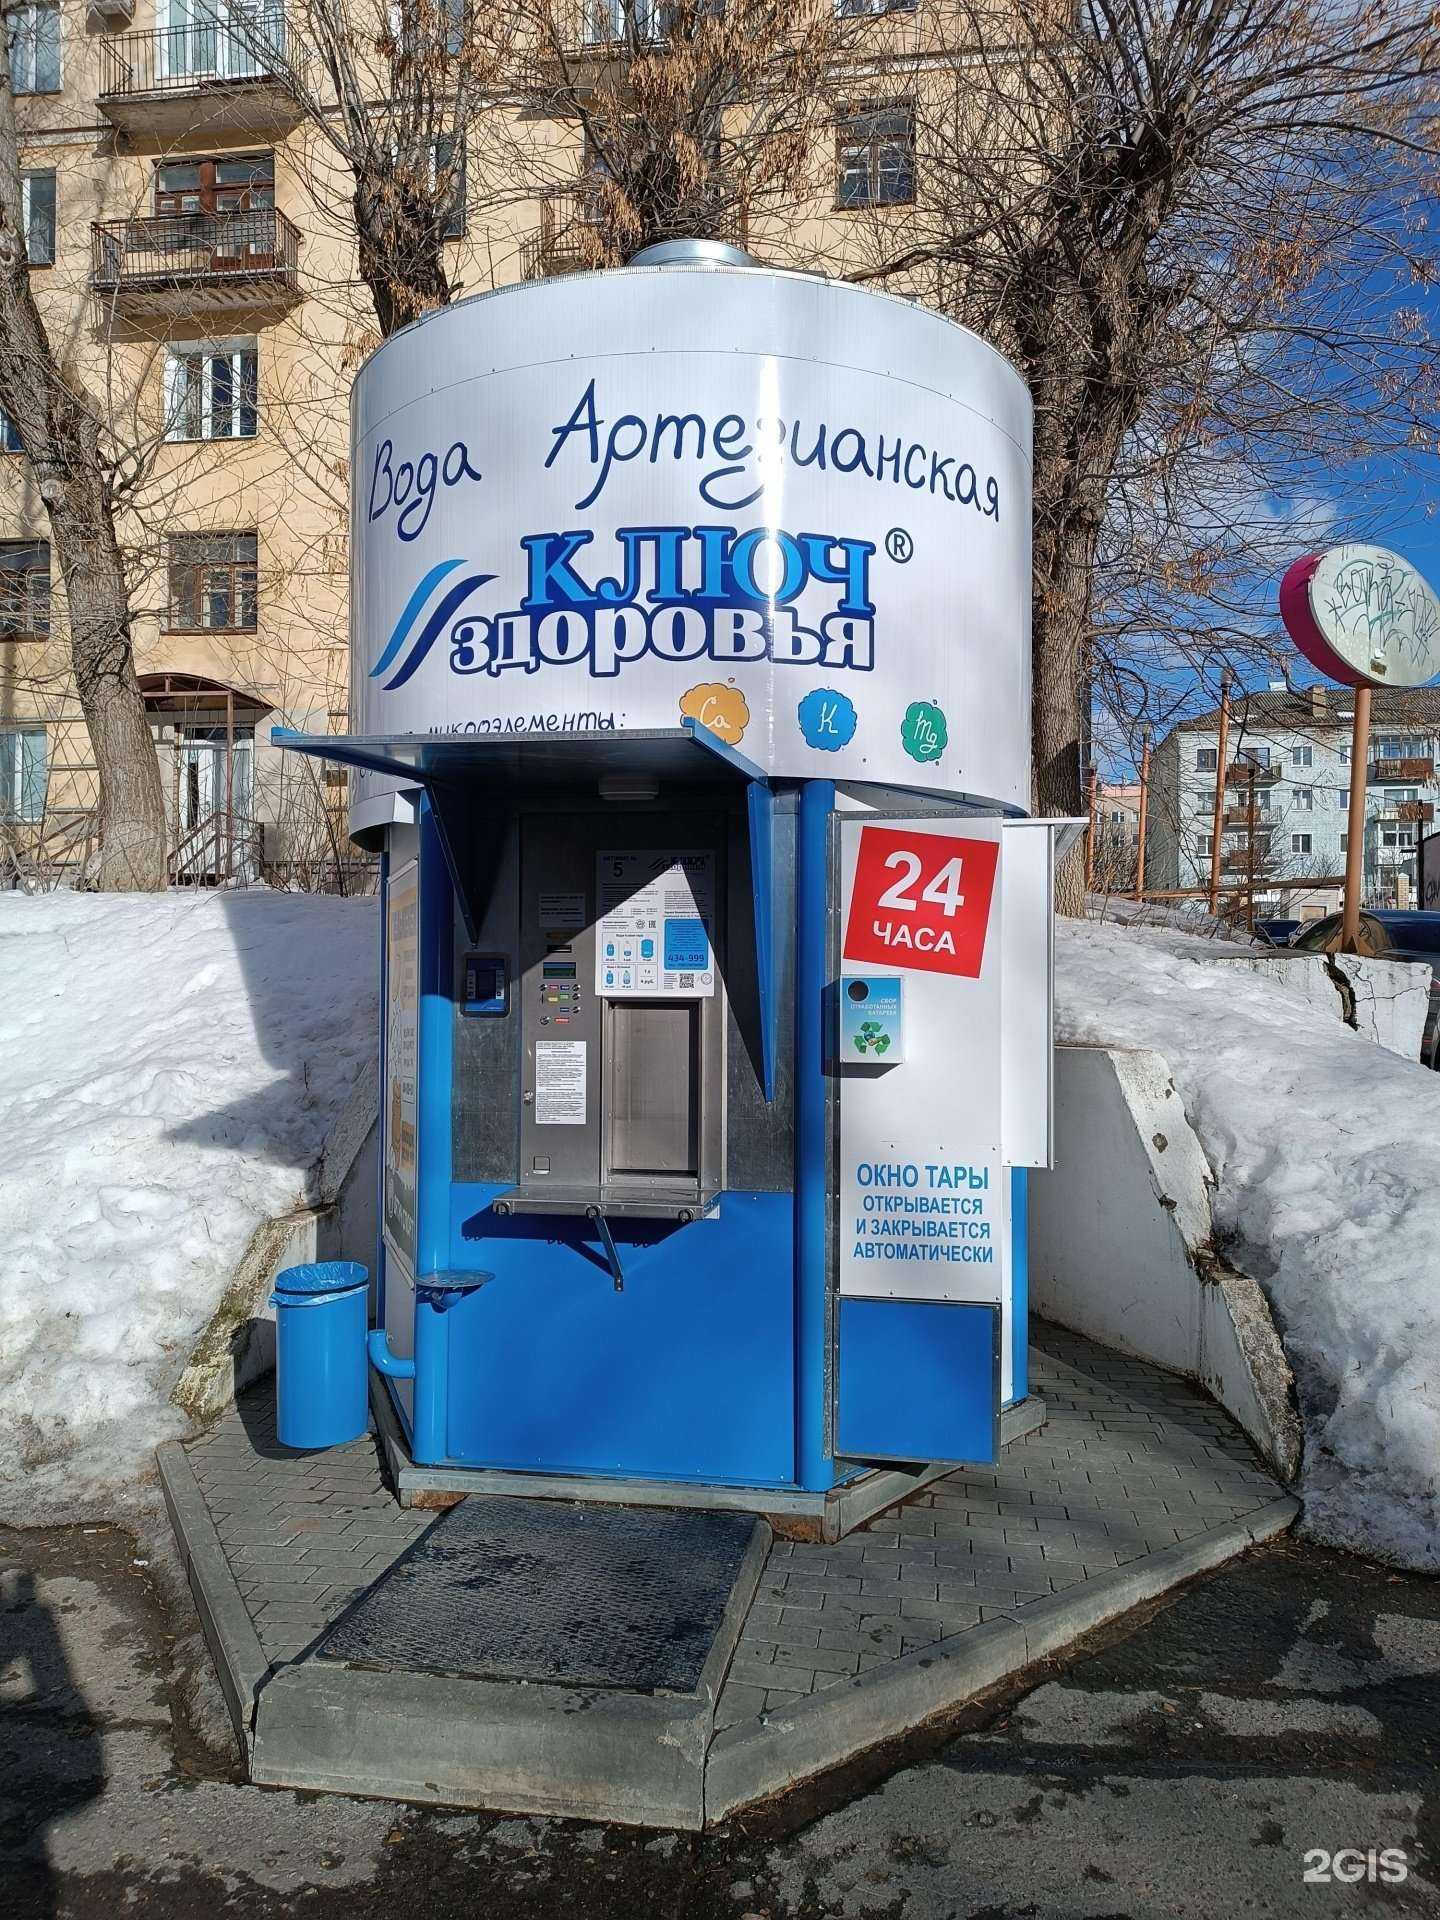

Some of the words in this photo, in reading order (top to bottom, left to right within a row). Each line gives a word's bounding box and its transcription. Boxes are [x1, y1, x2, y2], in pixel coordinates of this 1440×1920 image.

[367, 439, 482, 542] Вода
[544, 378, 1000, 523] Артезианская
[817, 702, 839, 735] K
[913, 710, 939, 754] Mg
[878, 850, 966, 917] 24
[873, 920, 957, 955] ЧАСА
[856, 1163, 919, 1188] ОКНО
[924, 1165, 989, 1190] ТАРЫ
[863, 1194, 983, 1215] ОТКРЫВАЕТСЯ
[856, 1217, 867, 1235] И
[871, 1218, 991, 1240] ЗАКРЫВАЕТСЯ
[853, 1241, 993, 1264] АВТОМАТИЧЕСКИ
